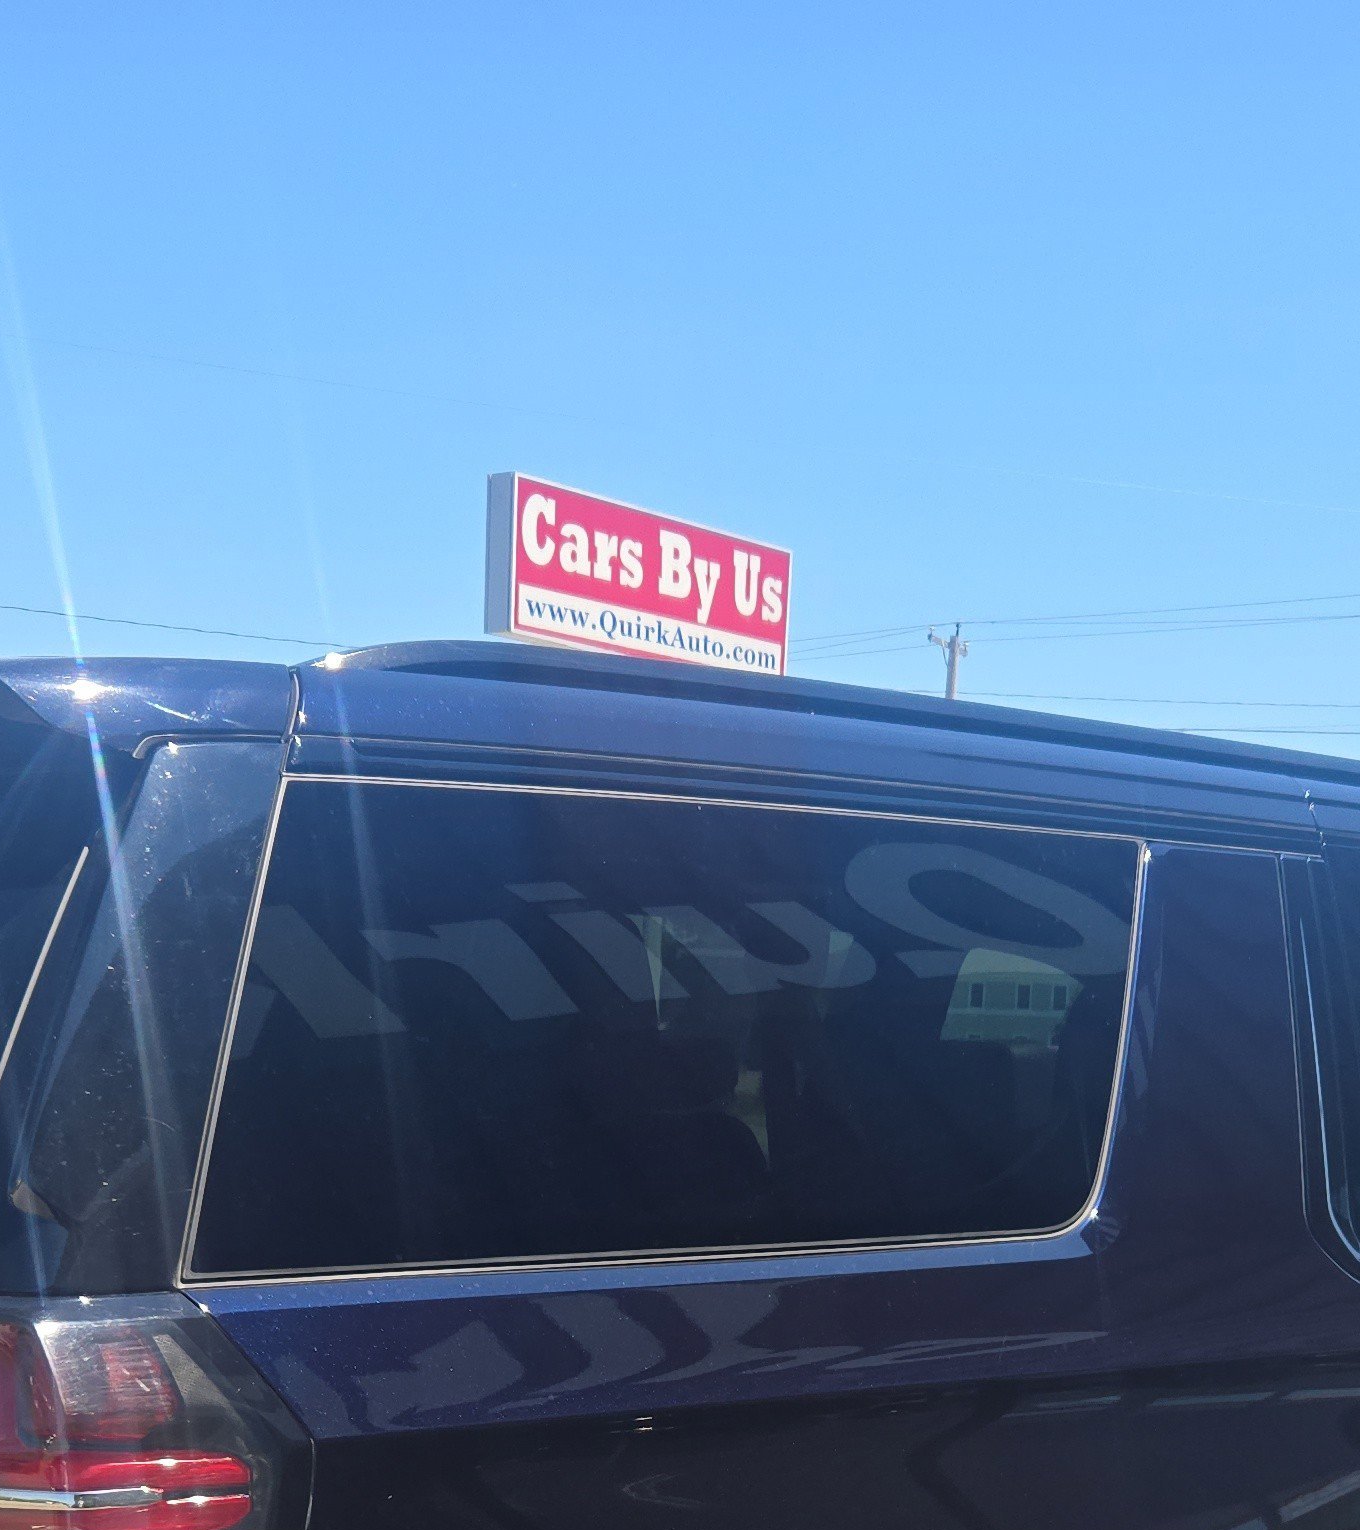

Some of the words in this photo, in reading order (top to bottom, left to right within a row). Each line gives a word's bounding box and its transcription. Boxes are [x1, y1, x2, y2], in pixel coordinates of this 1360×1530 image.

[521, 493, 644, 589] Cars
[658, 529, 721, 625] By
[733, 549, 783, 624] Us
[525, 597, 777, 671] www.QuirkAuto.com
